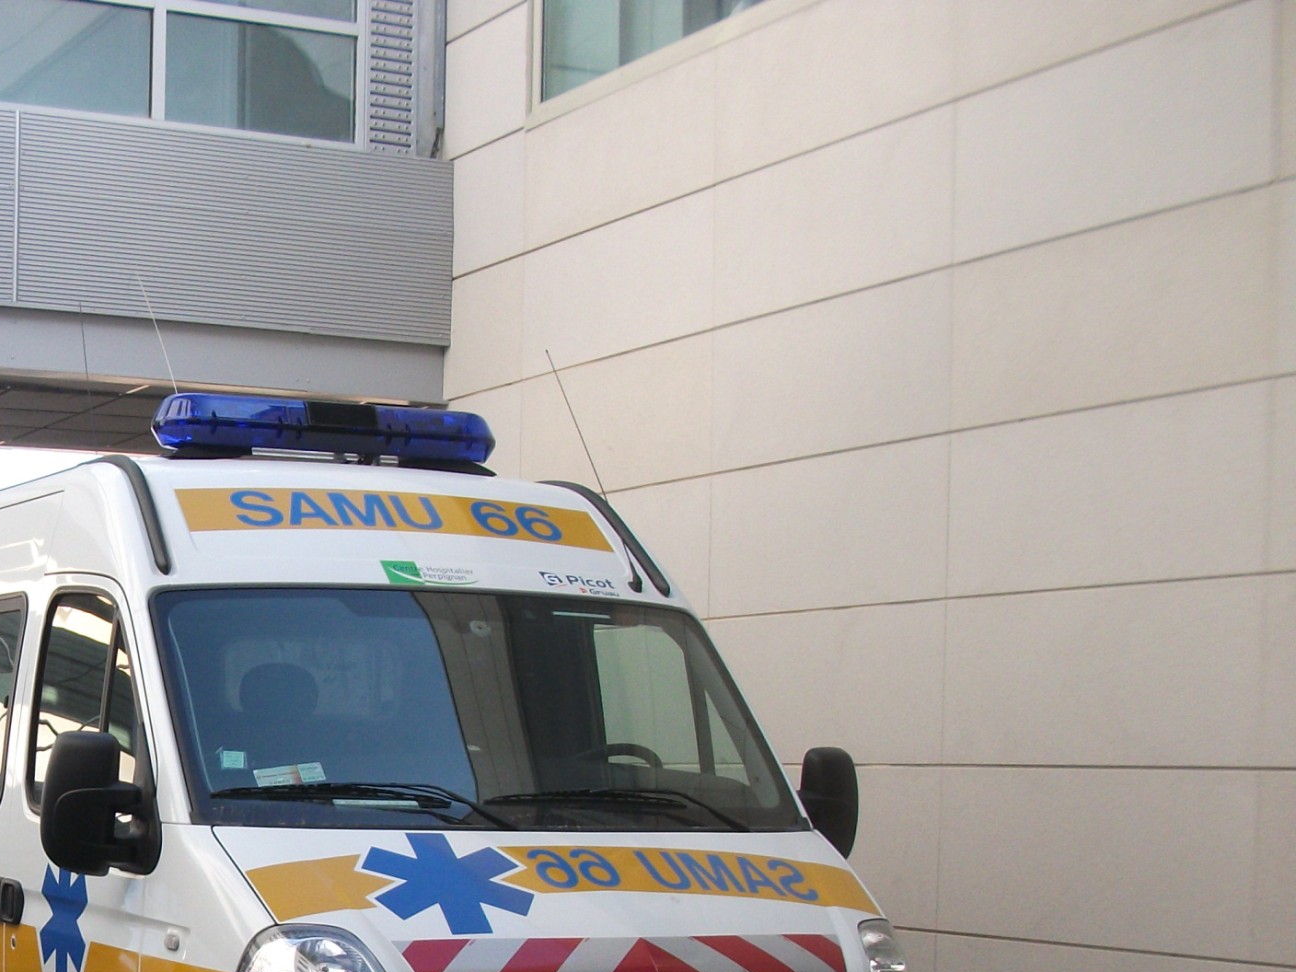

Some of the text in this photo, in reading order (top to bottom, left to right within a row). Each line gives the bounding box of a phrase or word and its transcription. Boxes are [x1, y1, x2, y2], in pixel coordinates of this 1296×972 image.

[230, 490, 563, 542] SAMU 66
[425, 565, 474, 576] Hospitalier
[565, 575, 616, 589] Picot
